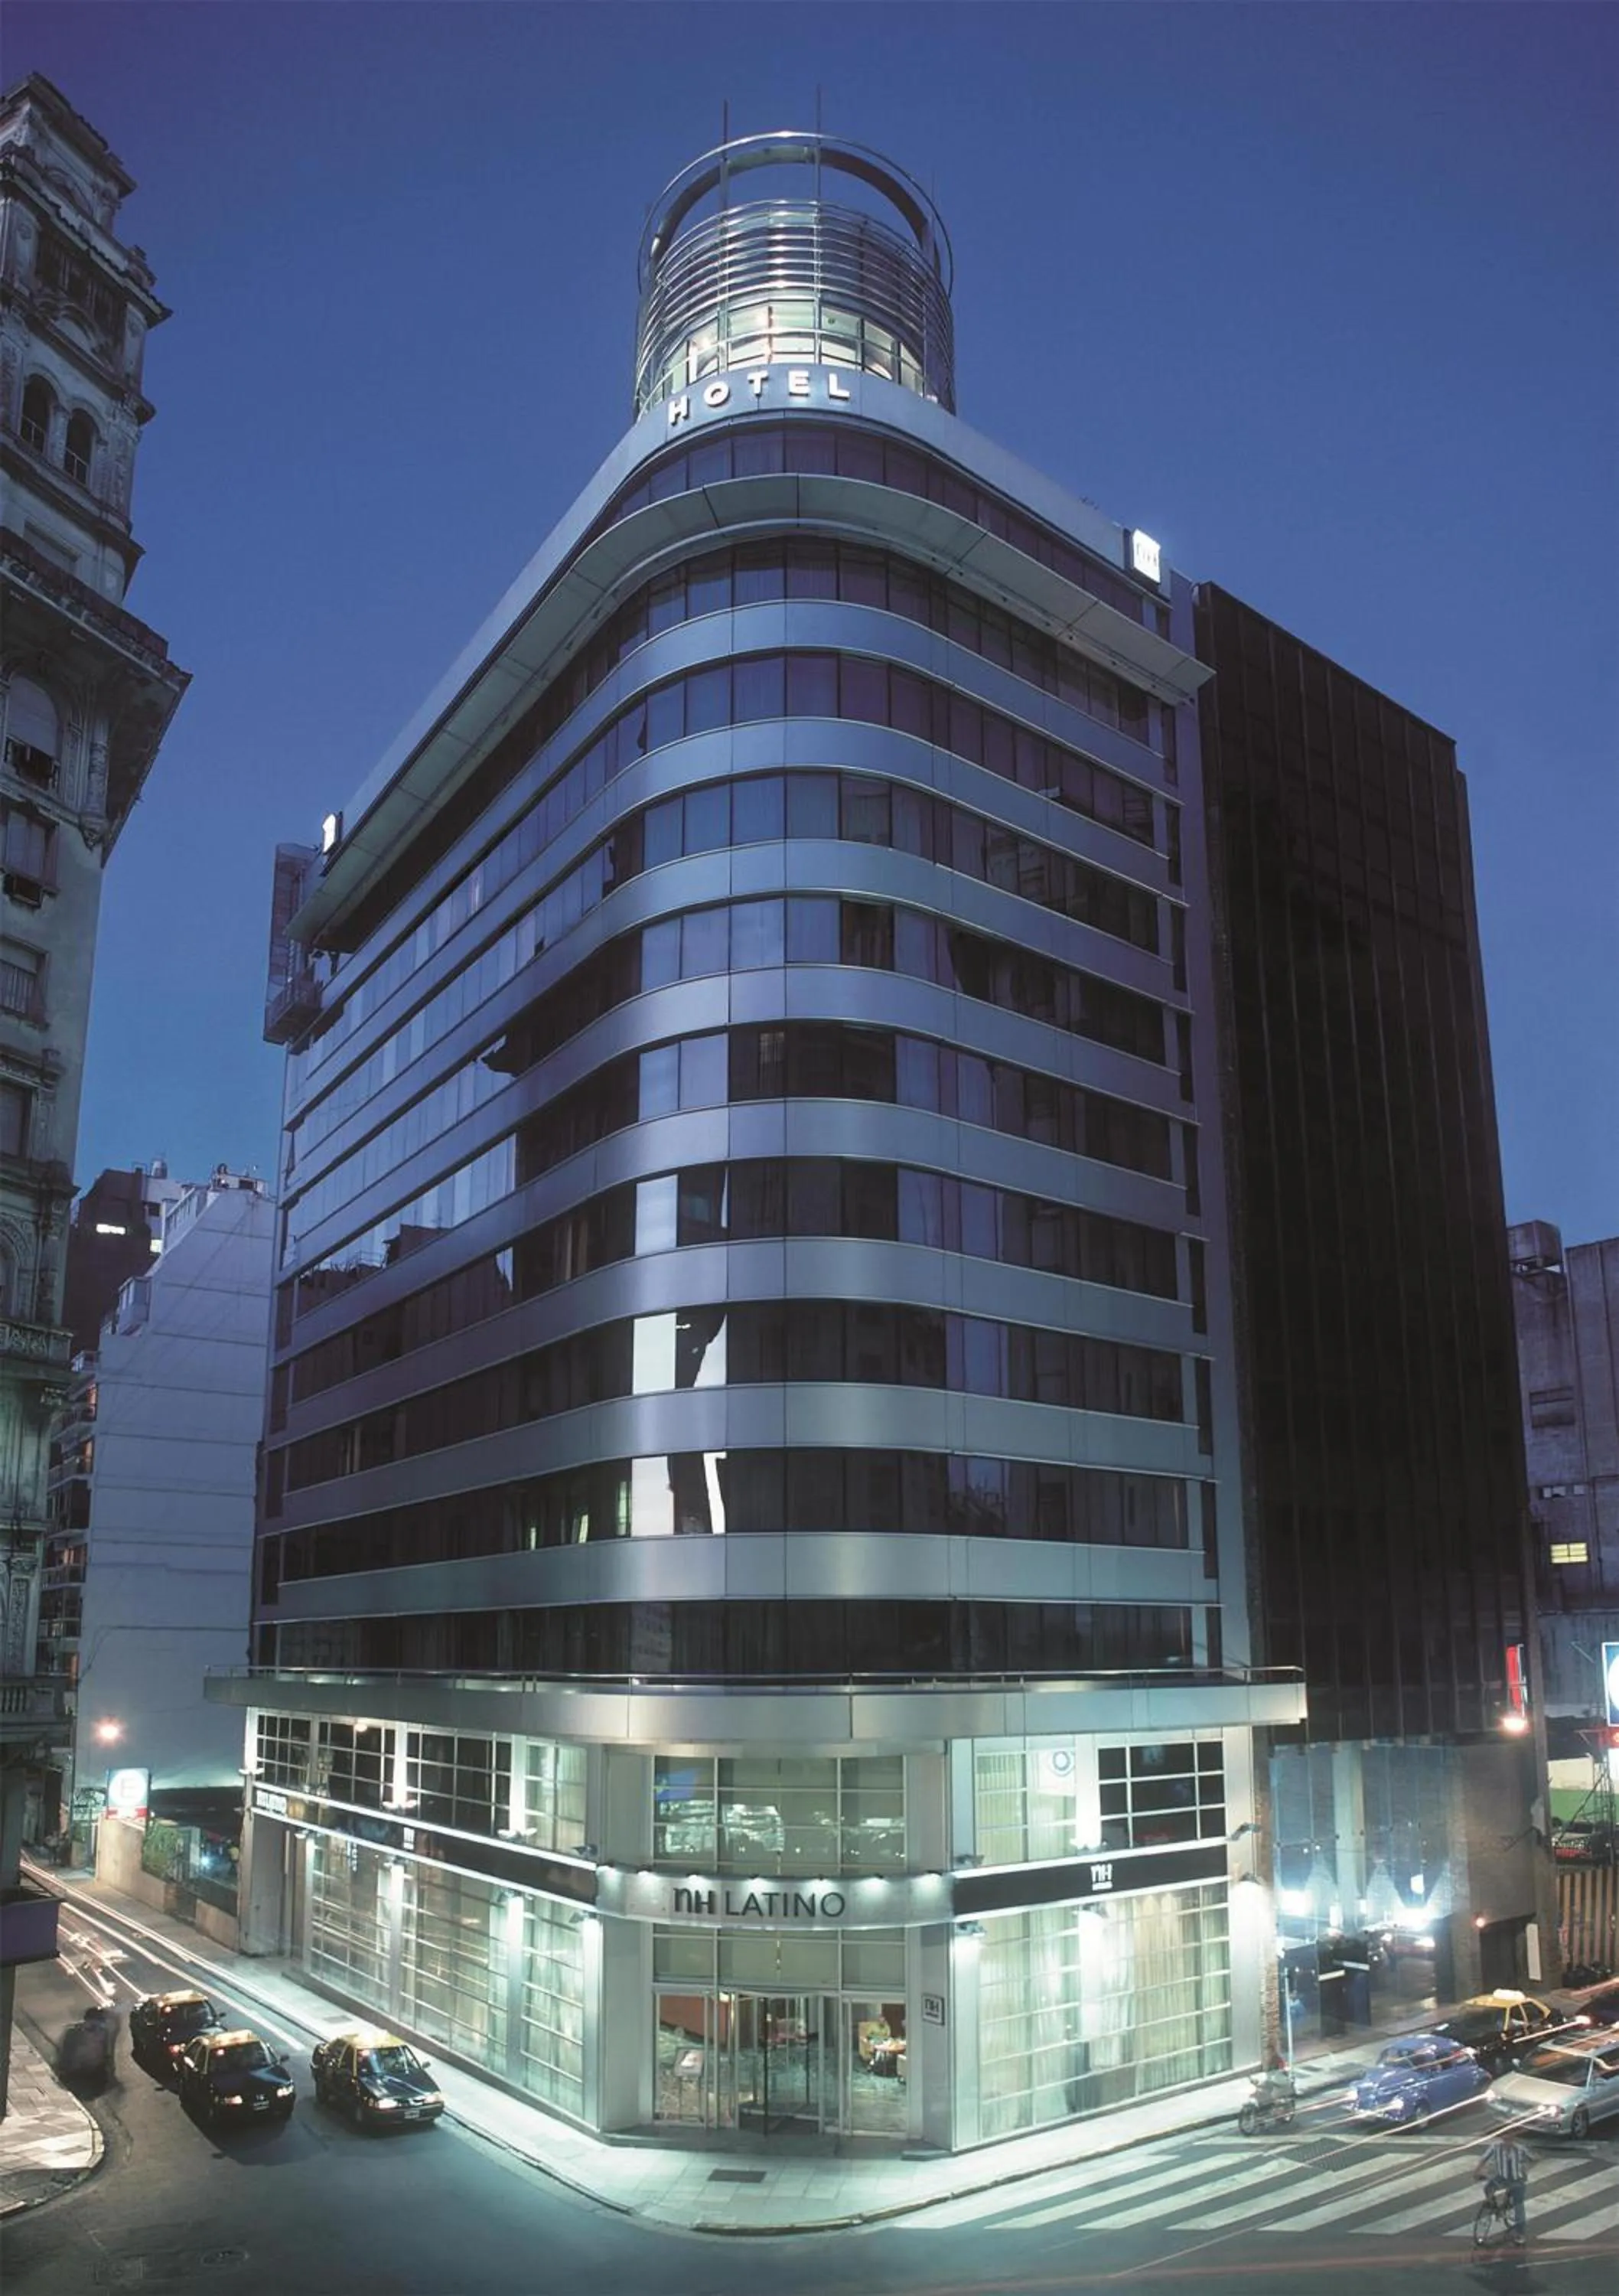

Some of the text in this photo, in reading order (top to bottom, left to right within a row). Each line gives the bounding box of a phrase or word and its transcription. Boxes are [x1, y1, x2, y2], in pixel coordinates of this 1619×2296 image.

[668, 370, 851, 427] HOTEL
[120, 1777, 138, 1799] E
[725, 1890, 845, 1917] LATINO
